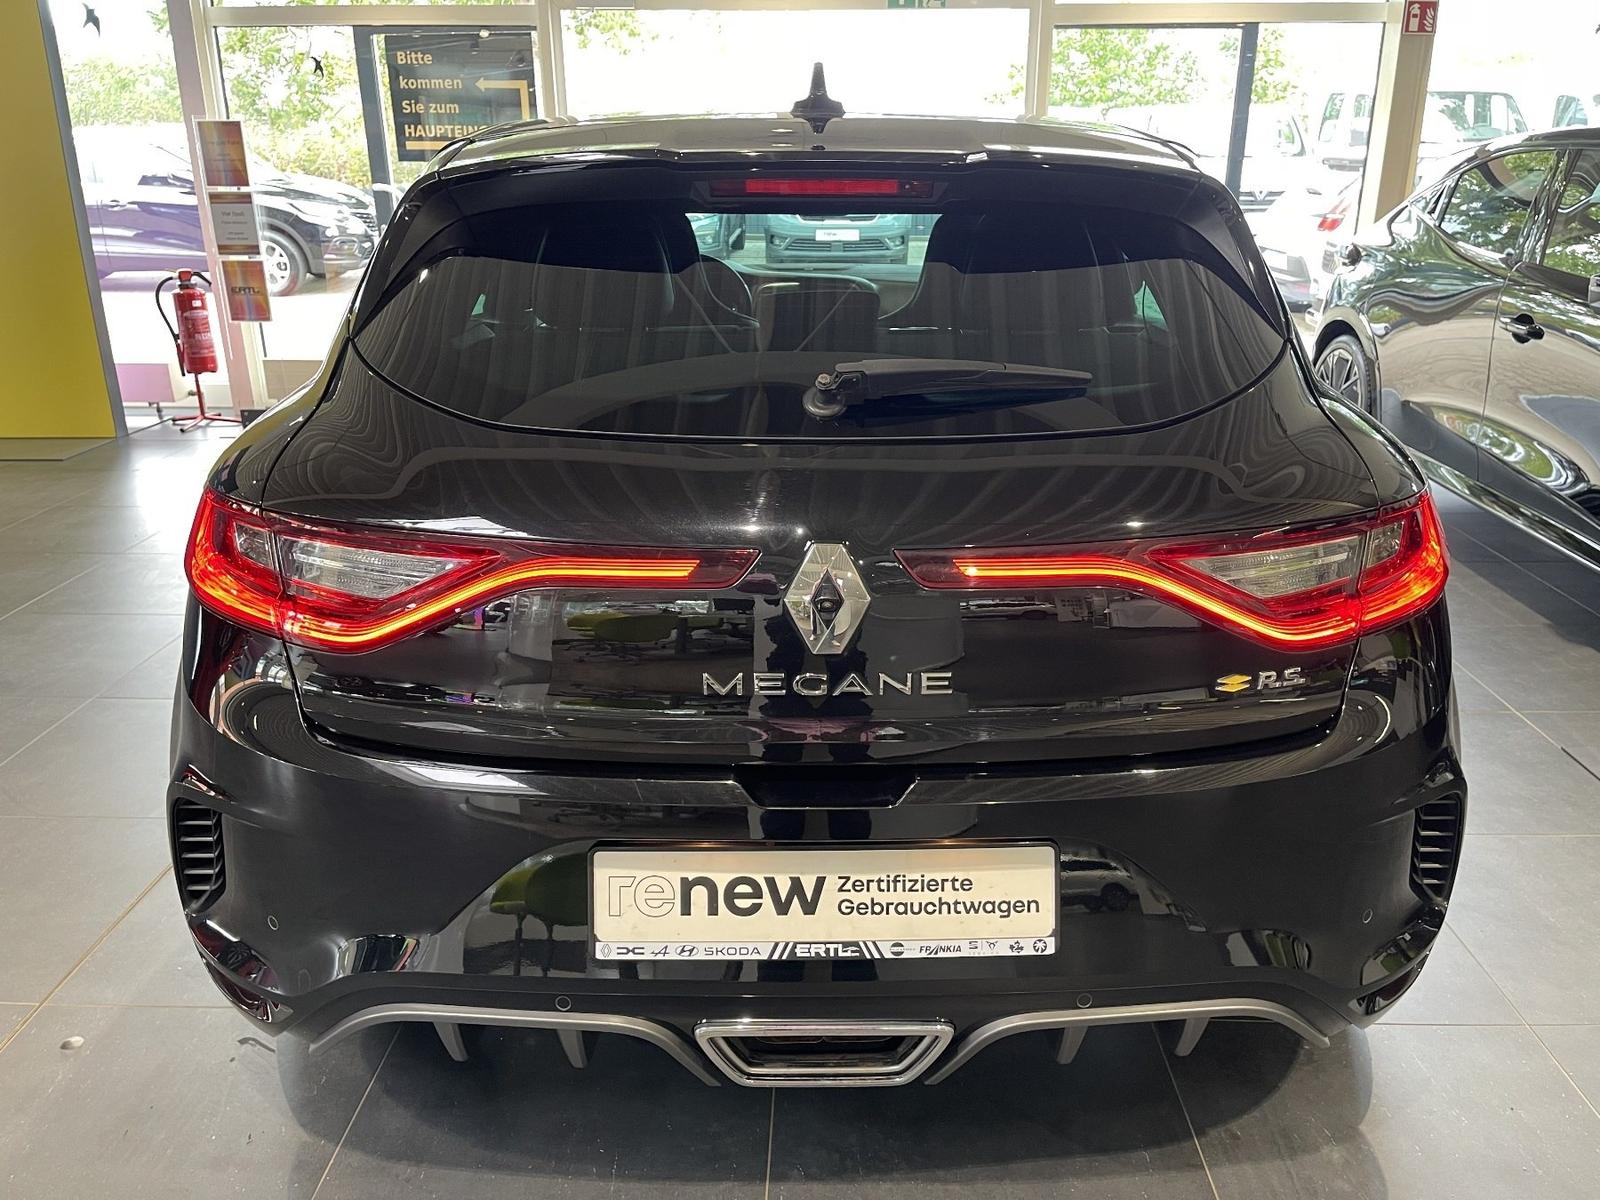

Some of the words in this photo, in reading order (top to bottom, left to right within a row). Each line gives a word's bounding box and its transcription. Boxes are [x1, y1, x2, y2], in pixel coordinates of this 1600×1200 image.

[397, 51, 433, 65] Bitte
[399, 76, 462, 89] kommen
[402, 101, 425, 114] Sie
[429, 103, 459, 114] zum
[404, 124, 489, 138] HAUPTEIN
[702, 672, 953, 696] MEGANE
[837, 874, 973, 893] Zertifizierte
[608, 874, 827, 918] renew
[837, 897, 1040, 919] Gebrauchtwagen
[795, 943, 852, 957] ERTL
